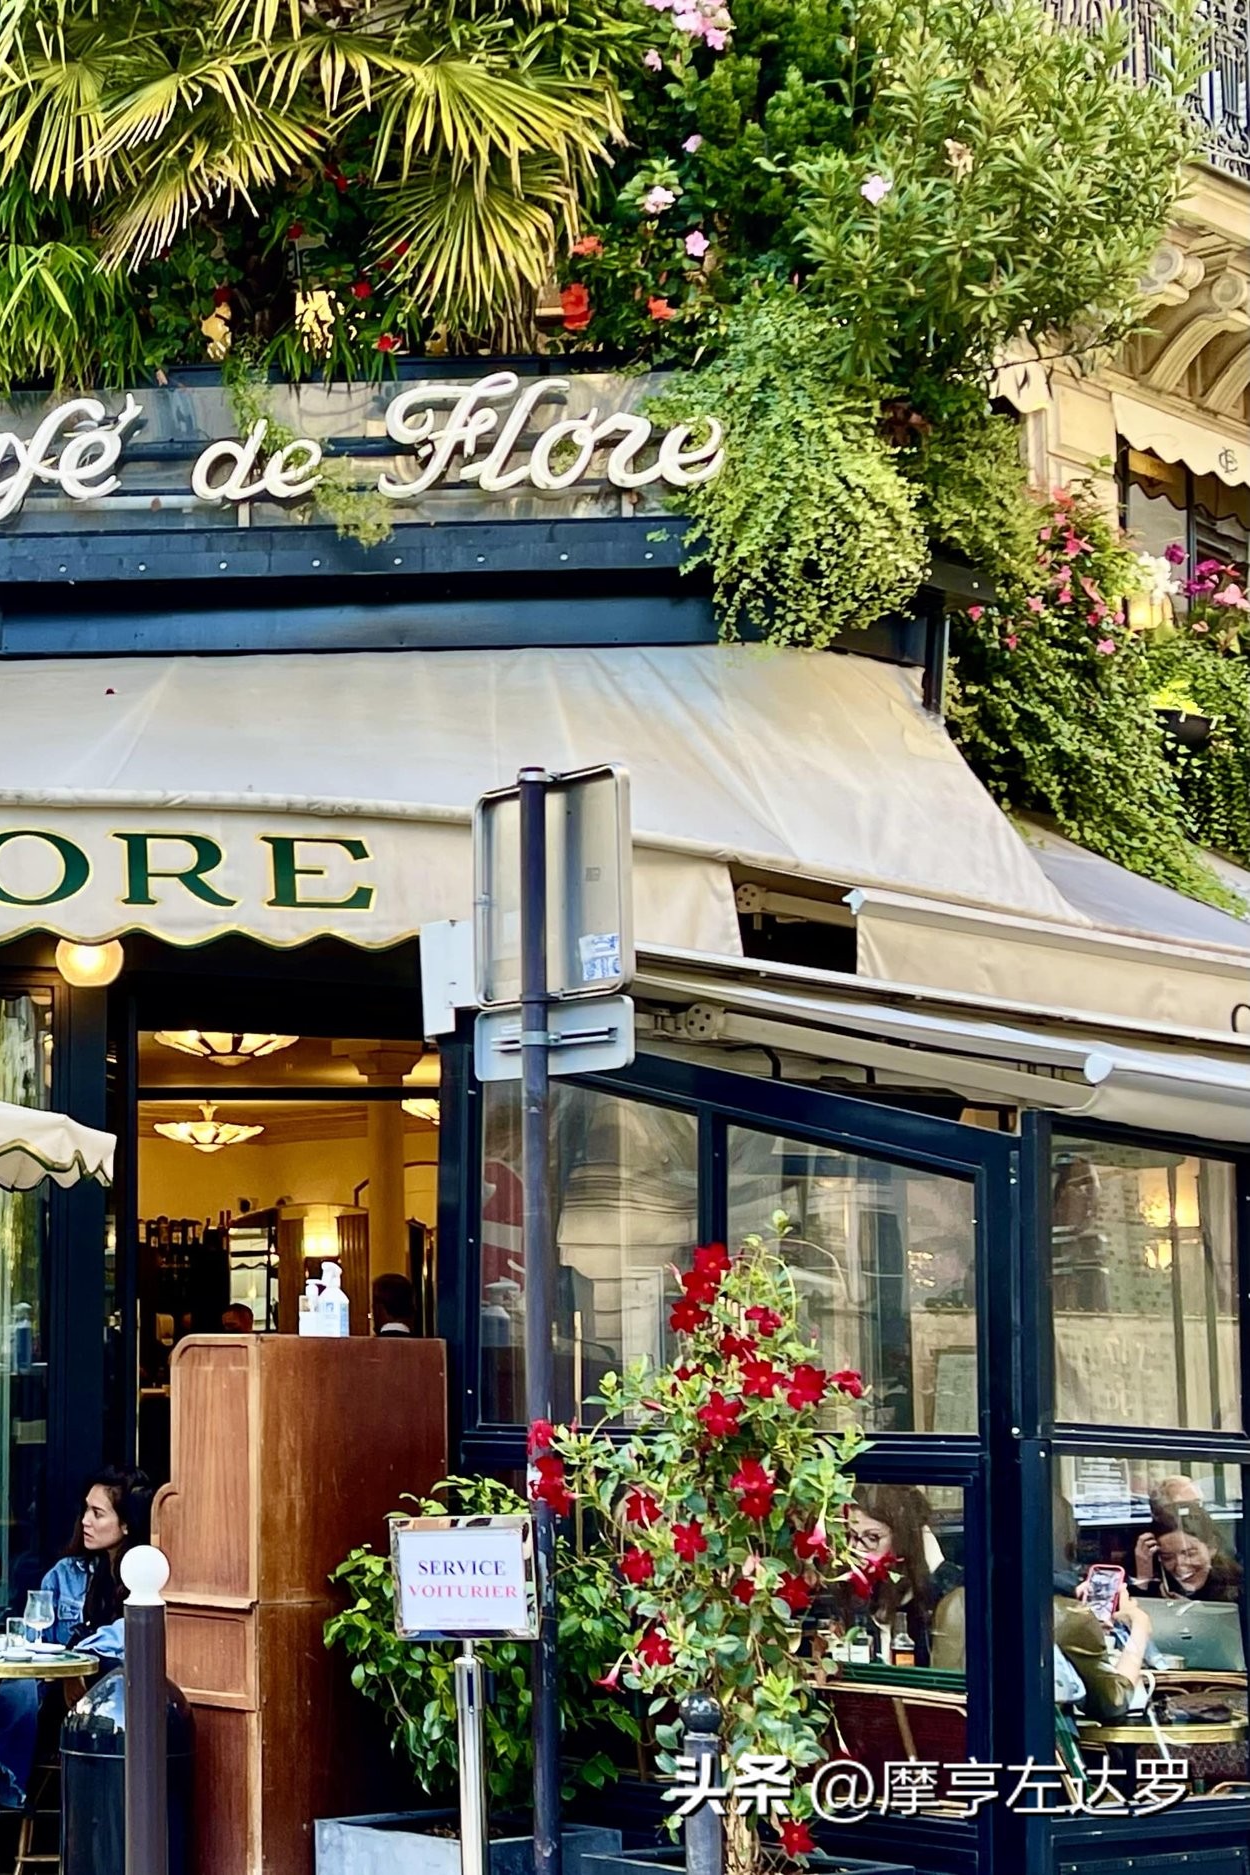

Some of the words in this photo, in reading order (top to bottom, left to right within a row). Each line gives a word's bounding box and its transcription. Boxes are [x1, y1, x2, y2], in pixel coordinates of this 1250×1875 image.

[191, 418, 324, 500] de
[378, 371, 726, 499] Flore
[418, 1560, 506, 1576] SERVICE
[408, 1584, 518, 1599] VOITURIER
